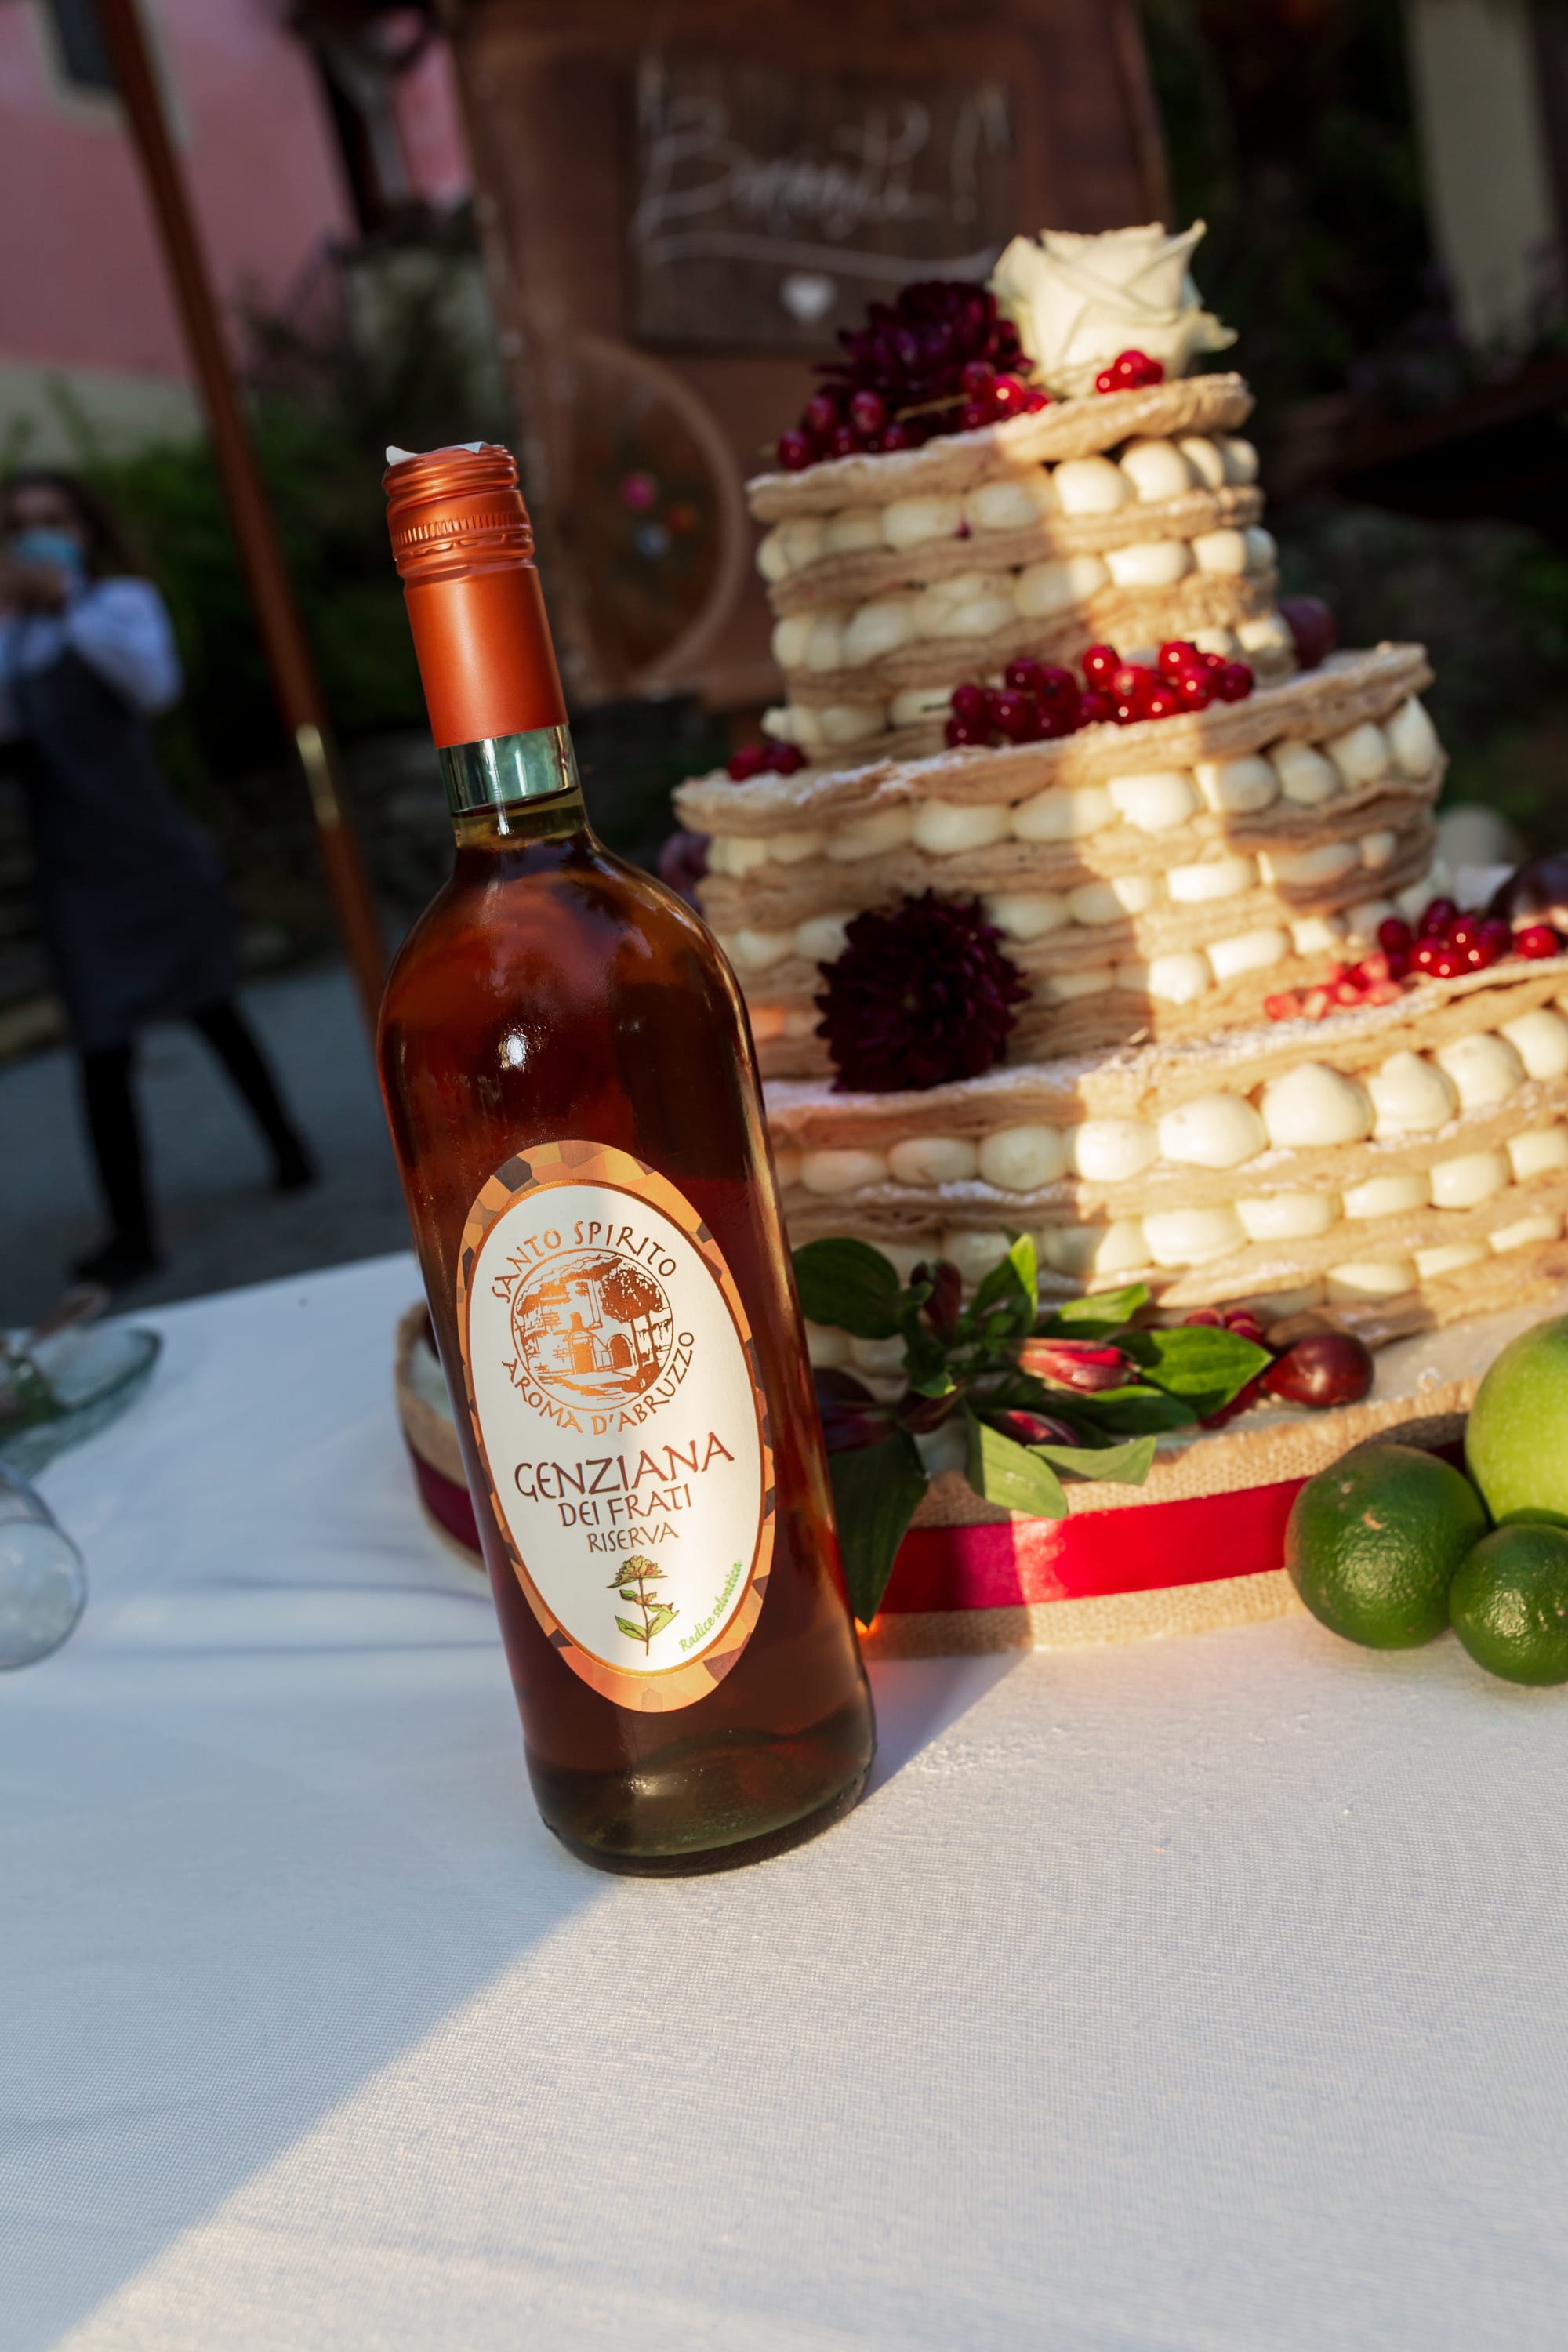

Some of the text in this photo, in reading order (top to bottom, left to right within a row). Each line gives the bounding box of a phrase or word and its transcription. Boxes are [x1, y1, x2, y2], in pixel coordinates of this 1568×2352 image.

[492, 1220, 677, 1303] SANTO SPIRITO
[501, 1331, 695, 1436] AROMA D'ABRUZZO
[514, 1432, 735, 1502] GENZIANA
[557, 1483, 692, 1527] DEI FRATI
[587, 1522, 680, 1552] RISERVA
[678, 1617, 715, 1652] Radice
